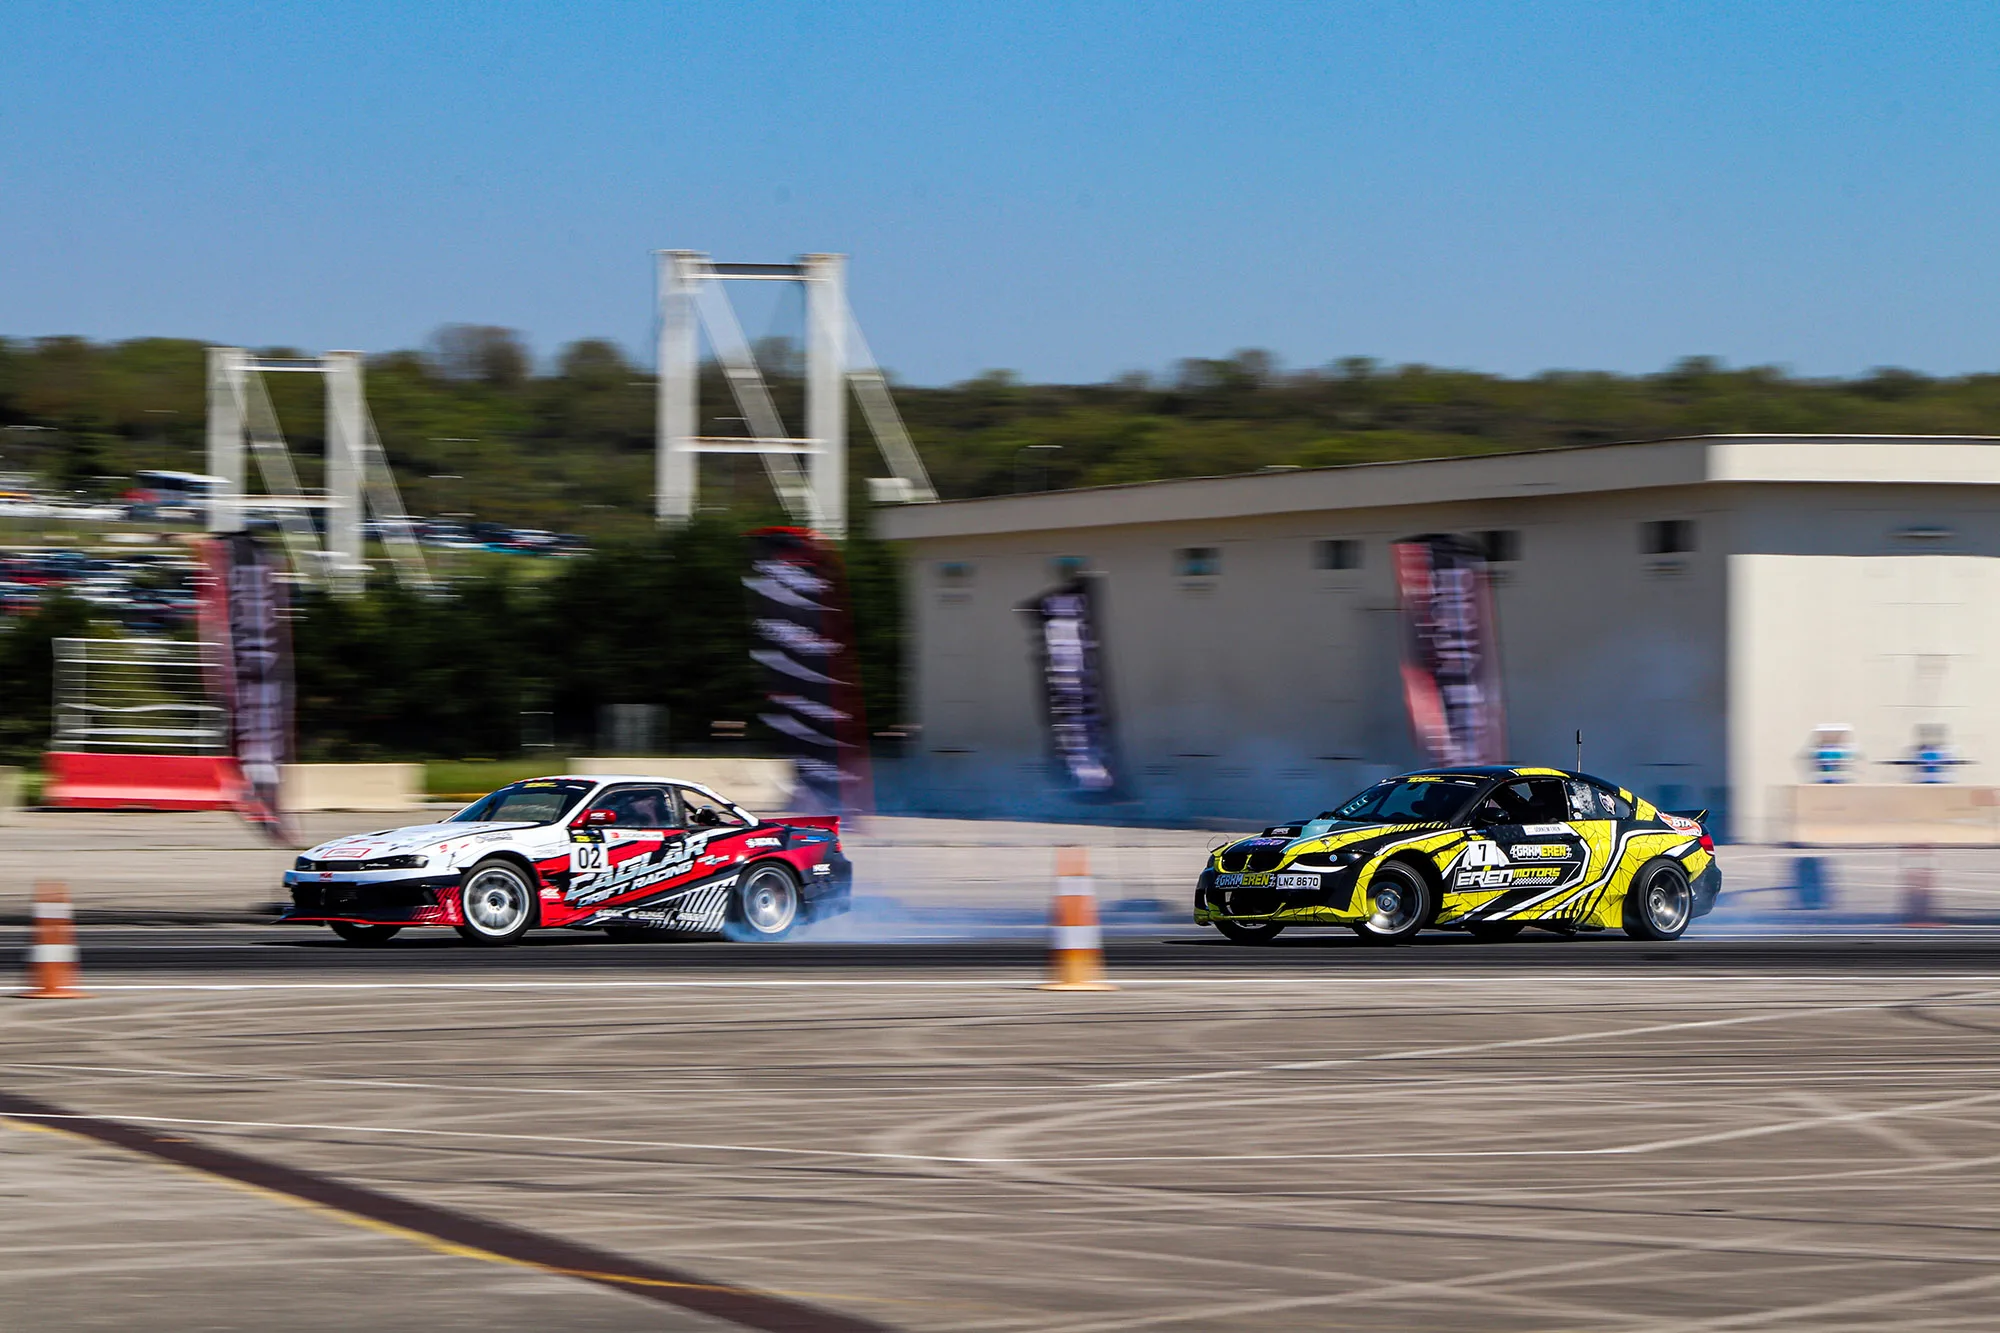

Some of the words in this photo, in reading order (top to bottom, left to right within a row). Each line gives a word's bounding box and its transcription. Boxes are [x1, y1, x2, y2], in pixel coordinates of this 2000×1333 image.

[1672, 818, 1692, 828] BTA
[578, 847, 602, 869] 02
[1478, 844, 1487, 862] 7
[576, 882, 631, 907] DRIFT
[631, 860, 694, 890] RACING
[1279, 876, 1295, 887] LNZ
[1296, 876, 1319, 887] 8670
[1457, 868, 1514, 888] EREN
[1513, 868, 1561, 878] MOTORS
